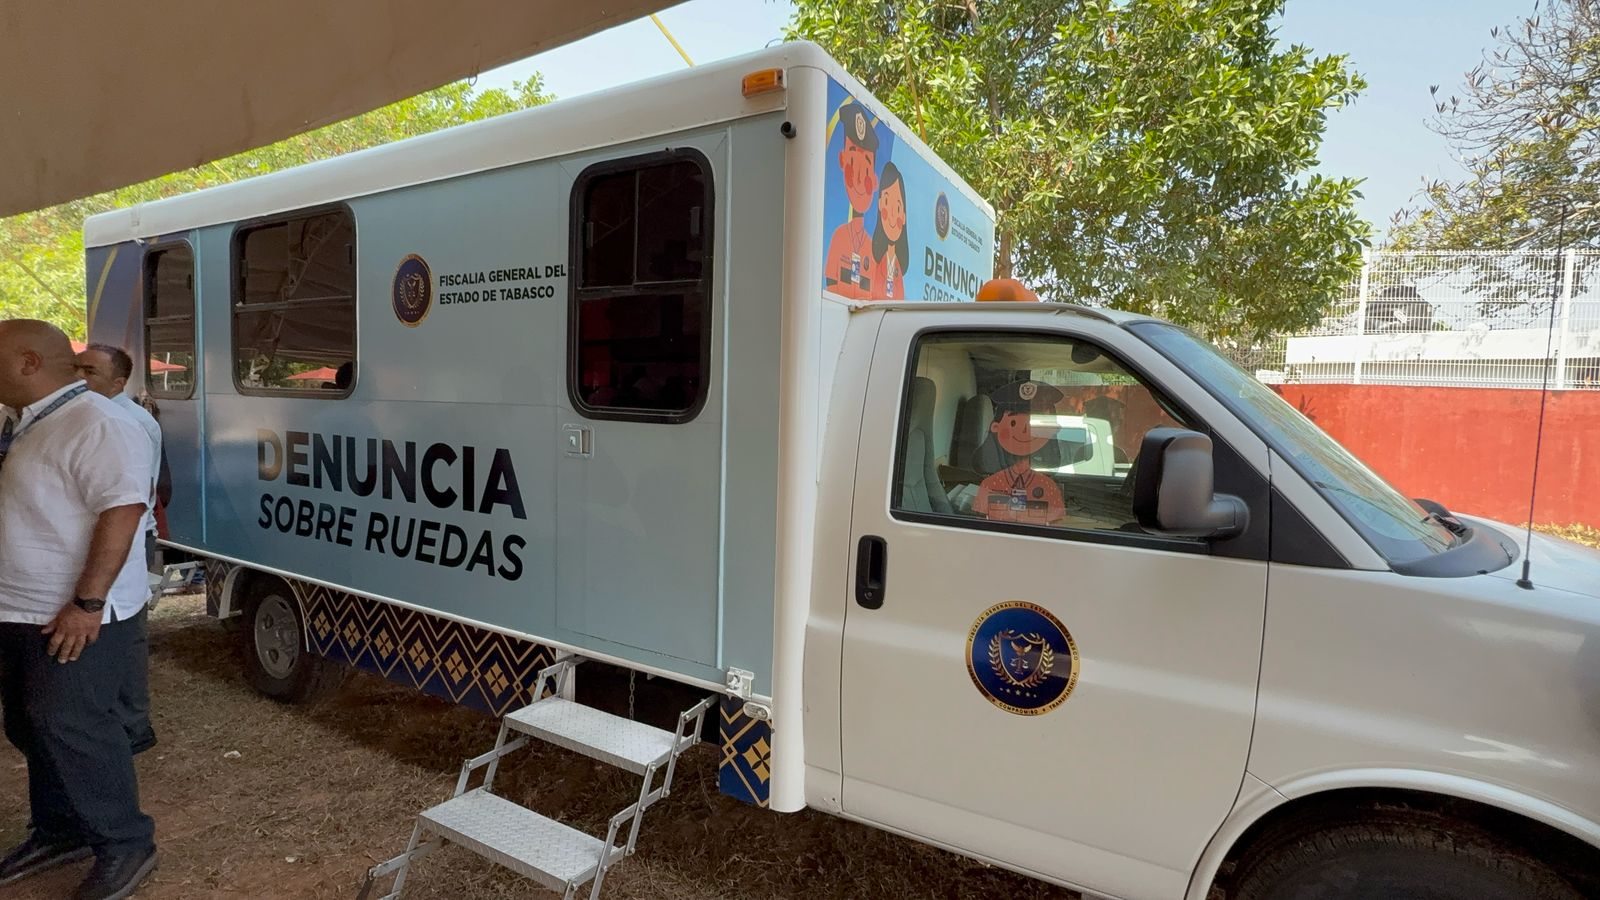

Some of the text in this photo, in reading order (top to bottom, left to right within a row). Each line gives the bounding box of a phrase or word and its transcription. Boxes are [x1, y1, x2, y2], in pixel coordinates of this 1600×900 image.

[439, 264, 567, 287] FISCALIA GENERAL DEL
[439, 285, 555, 305] ESTADO DE TABASCO
[257, 429, 527, 520] DENUNCIA
[258, 493, 527, 582] SOBRE RUEDAS
